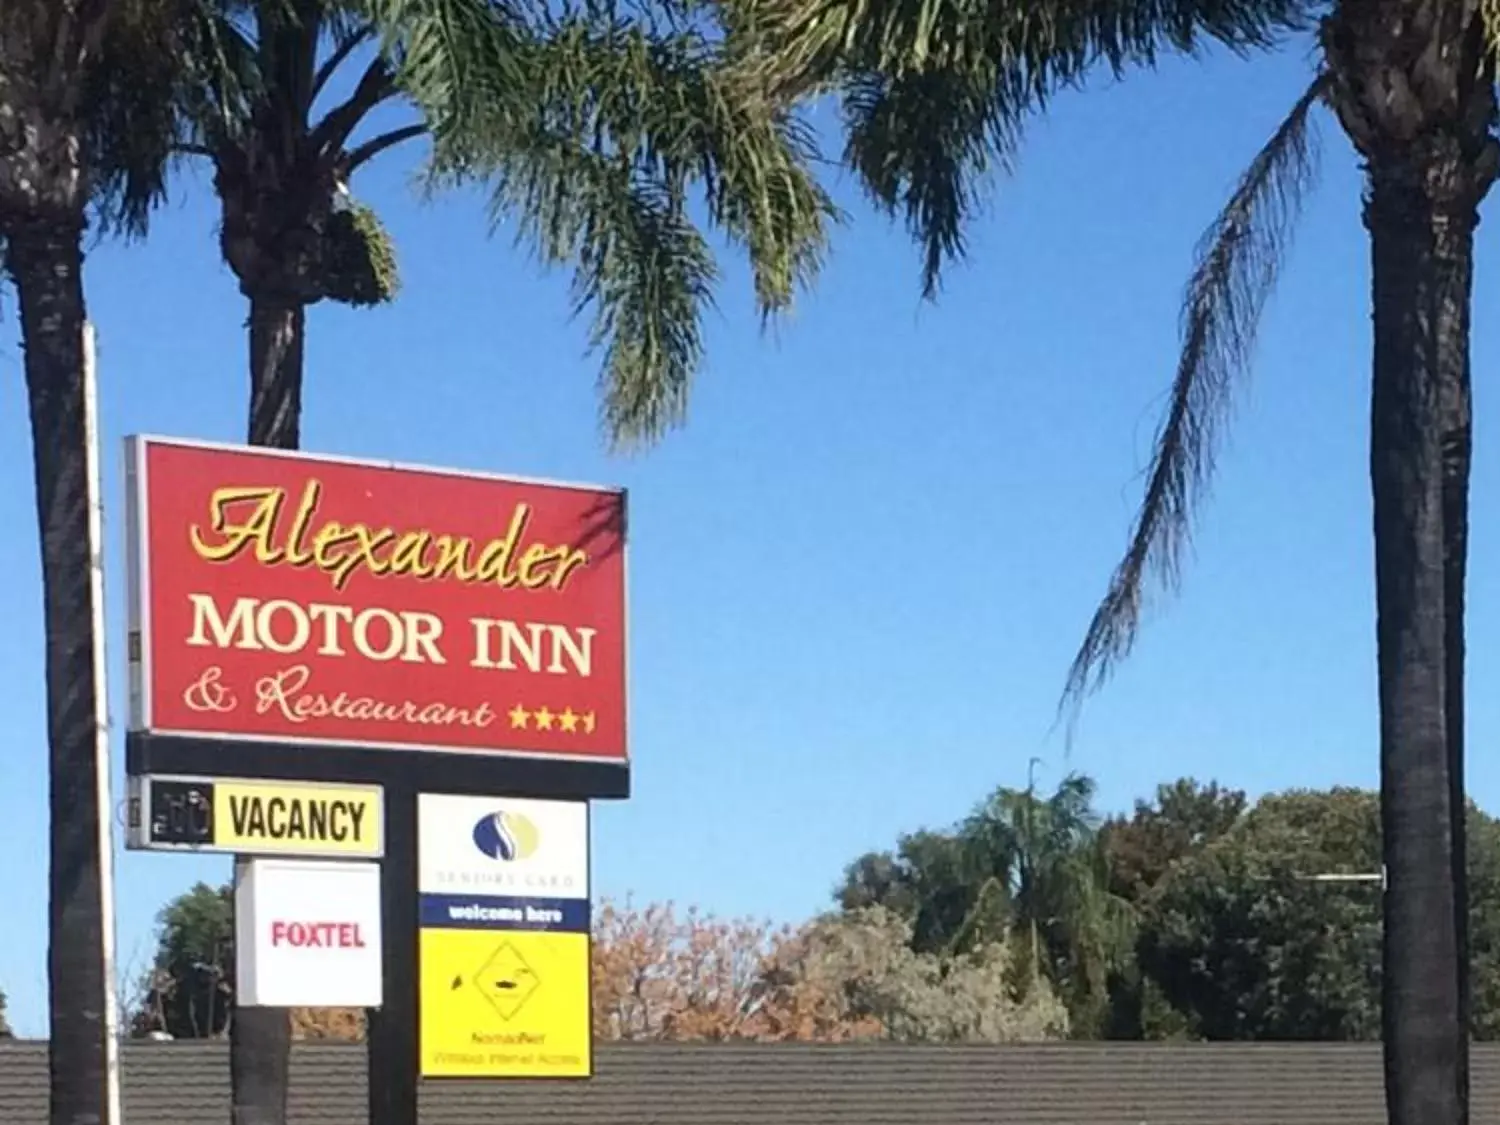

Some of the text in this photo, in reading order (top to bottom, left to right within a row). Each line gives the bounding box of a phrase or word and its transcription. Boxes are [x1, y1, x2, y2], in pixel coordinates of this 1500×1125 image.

[190, 477, 590, 592] Alexander
[186, 594, 597, 678] MOTOR INN
[183, 665, 498, 729] & Restaurant
[229, 795, 366, 842] VACANCY
[271, 921, 367, 948] FOXTEL
[448, 903, 563, 923] welcome here
